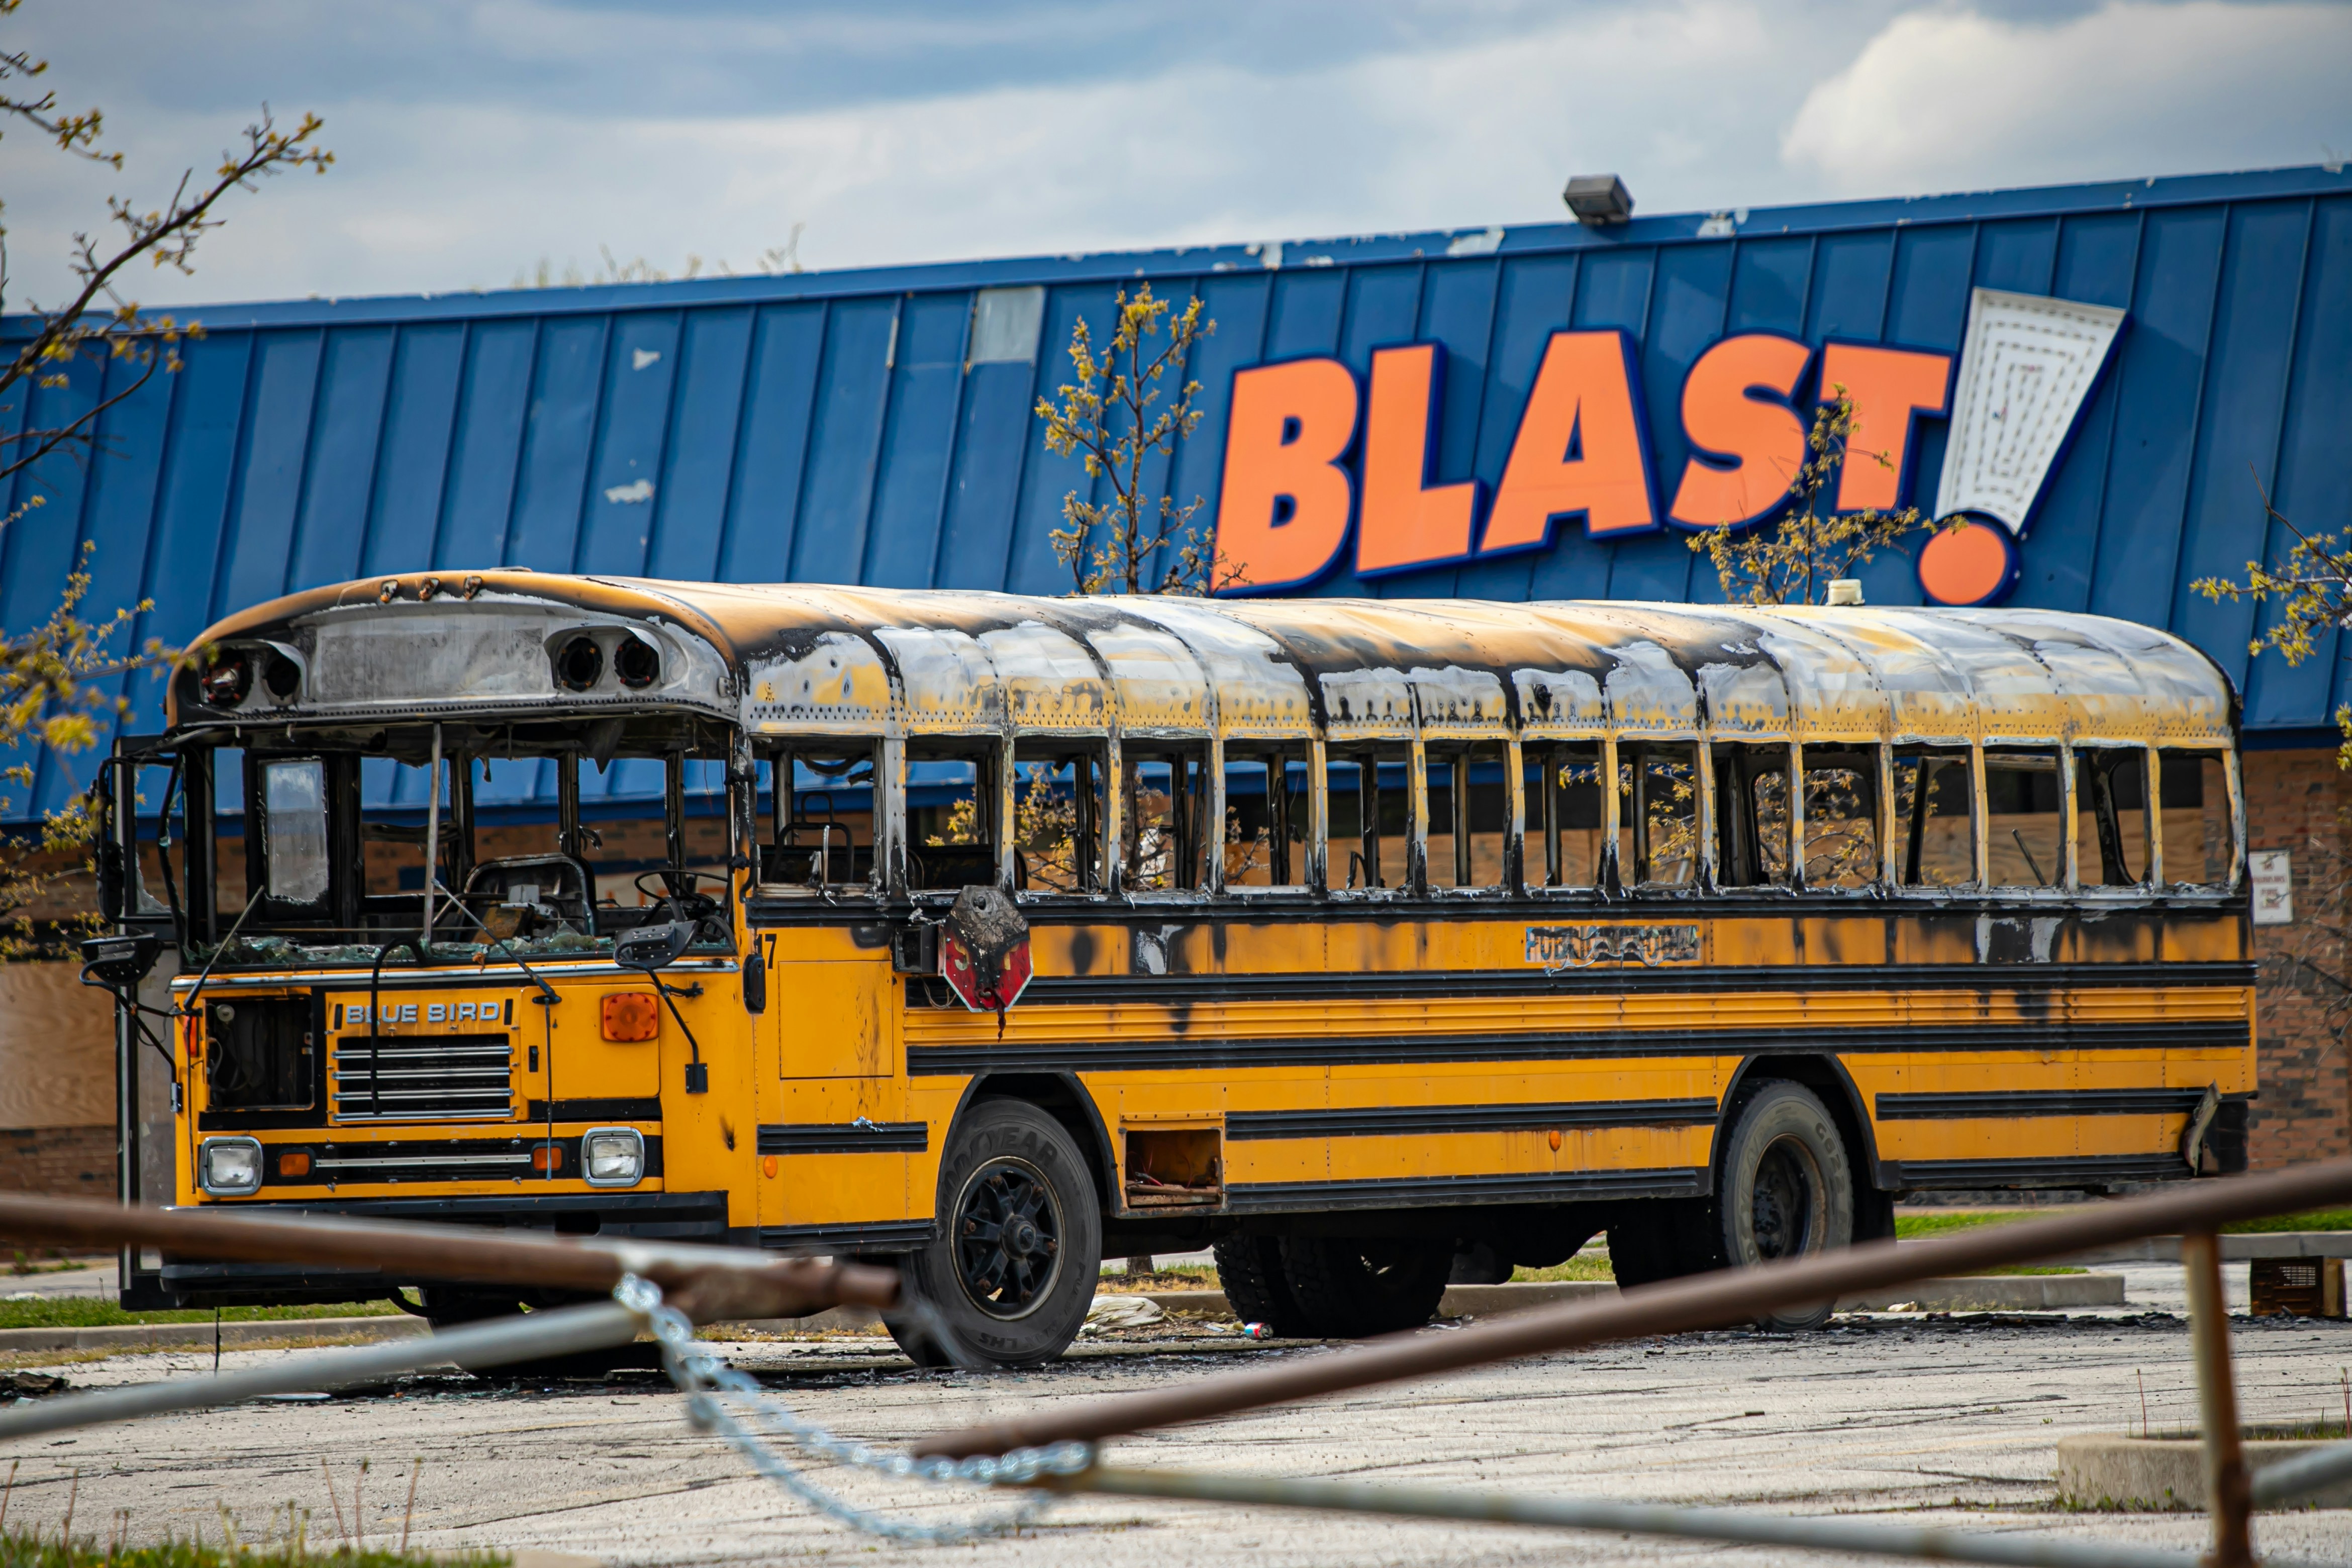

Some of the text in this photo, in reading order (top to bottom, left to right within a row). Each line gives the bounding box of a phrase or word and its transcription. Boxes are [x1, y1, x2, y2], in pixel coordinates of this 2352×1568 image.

[1210, 286, 2128, 605] BLAST!
[346, 1002, 500, 1024] BLUE BIRD
